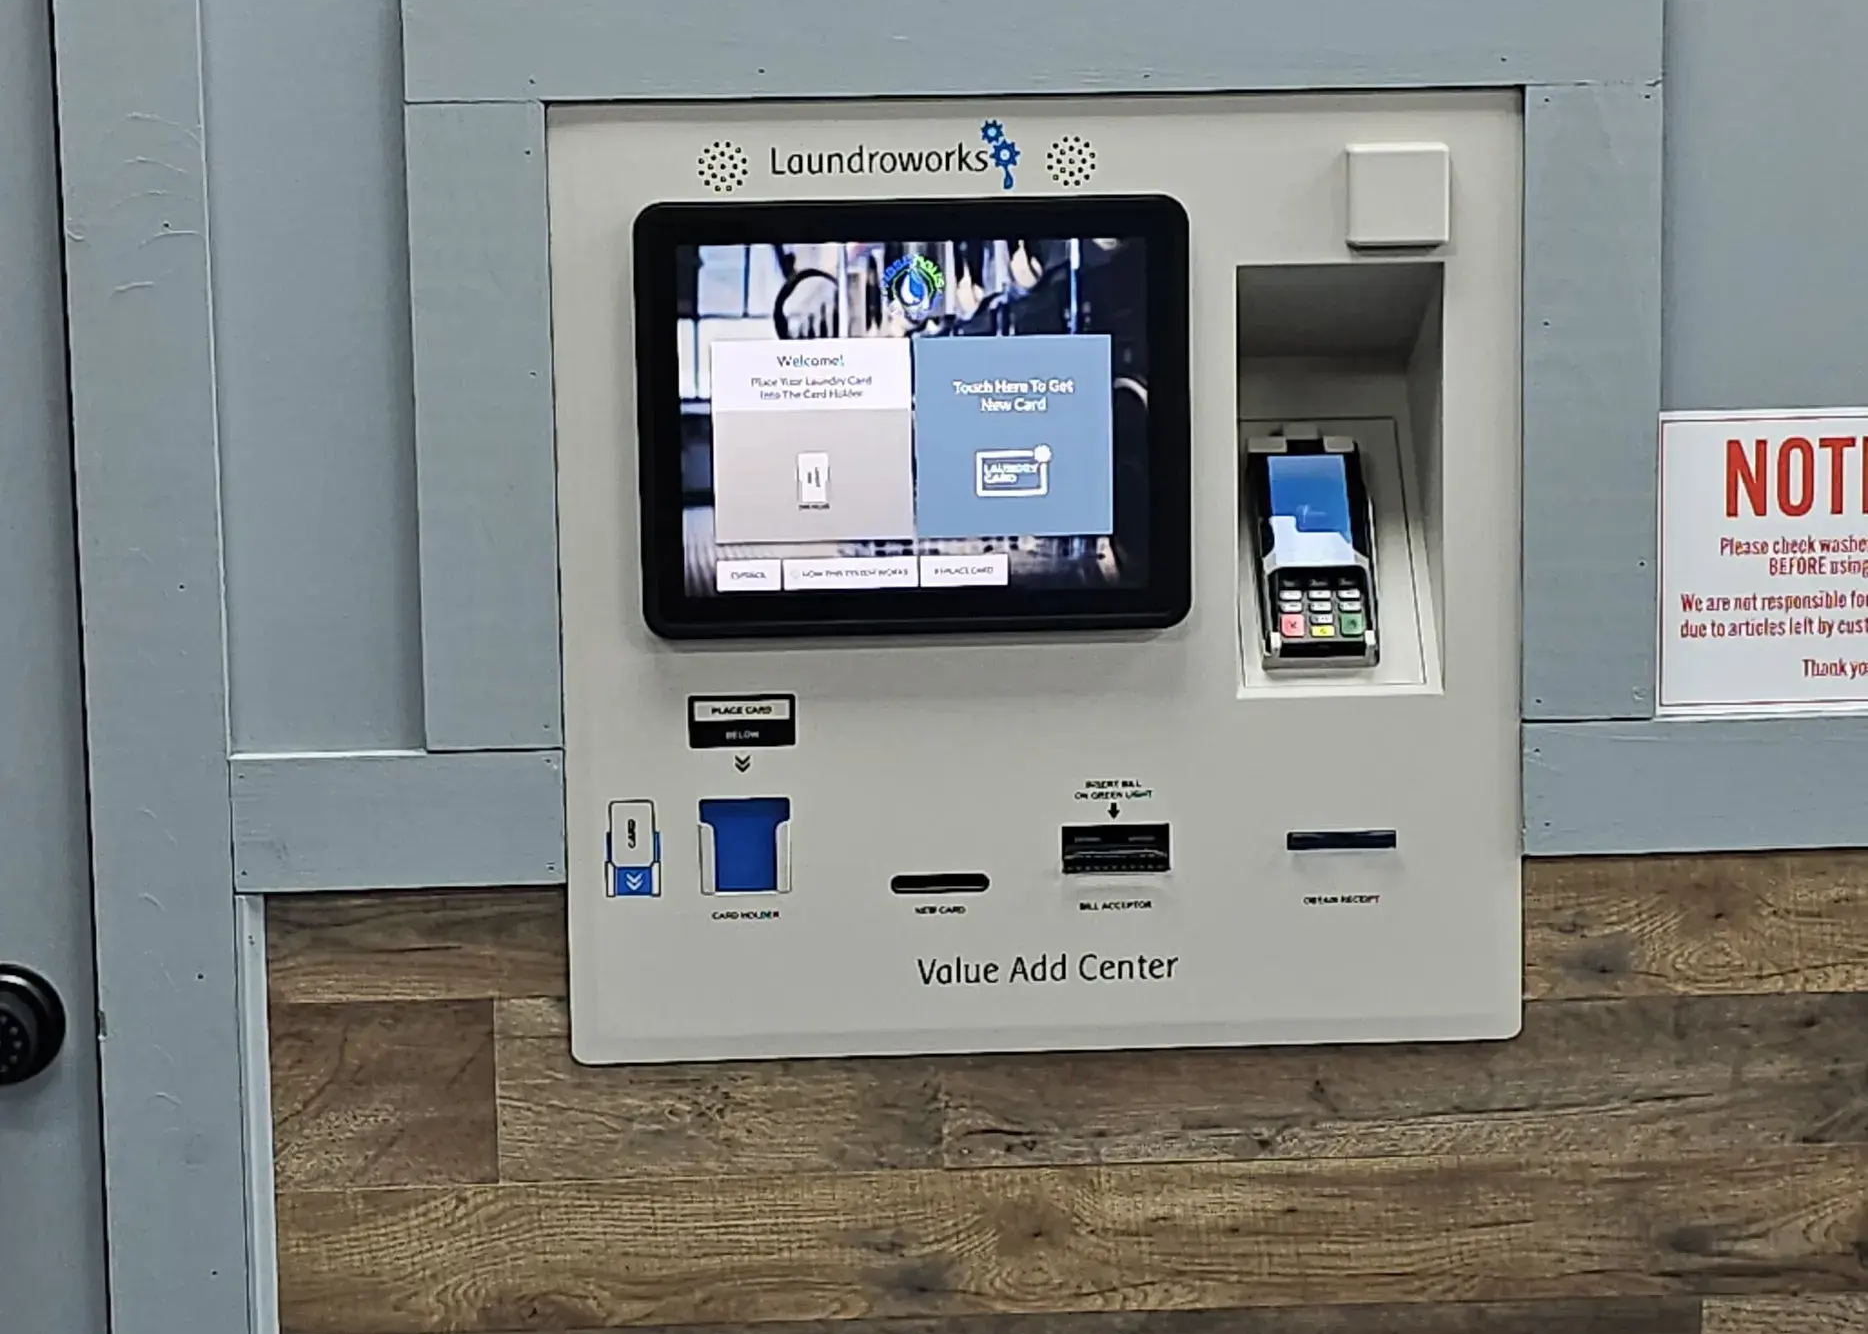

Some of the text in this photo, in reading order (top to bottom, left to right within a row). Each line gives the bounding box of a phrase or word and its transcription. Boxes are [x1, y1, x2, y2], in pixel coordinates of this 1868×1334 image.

[771, 141, 989, 175] Laundroworks
[952, 379, 1074, 395] Touch Here To Get
[980, 396, 1047, 412] New Card
[1720, 537, 1769, 556] Please
[1772, 534, 1817, 554] check
[1768, 555, 1868, 578] BEFORE using
[1680, 593, 1704, 613] We
[1705, 597, 1731, 612] are
[1733, 592, 1758, 612] not
[1761, 589, 1847, 614] responsible
[1680, 619, 1708, 639] due
[1710, 619, 1726, 638] to
[1727, 617, 1786, 637] articles
[1788, 615, 1815, 636] left
[1817, 614, 1835, 639] by
[1801, 658, 1848, 678] Thank
[710, 705, 773, 715] PLACE CARD
[725, 730, 760, 740] BELOW
[914, 905, 967, 915] NEW CARD
[1079, 900, 1152, 911] BILL ACCEPTOR
[711, 910, 780, 920] CARD HOLDER
[917, 953, 1179, 985] Value Add Center
